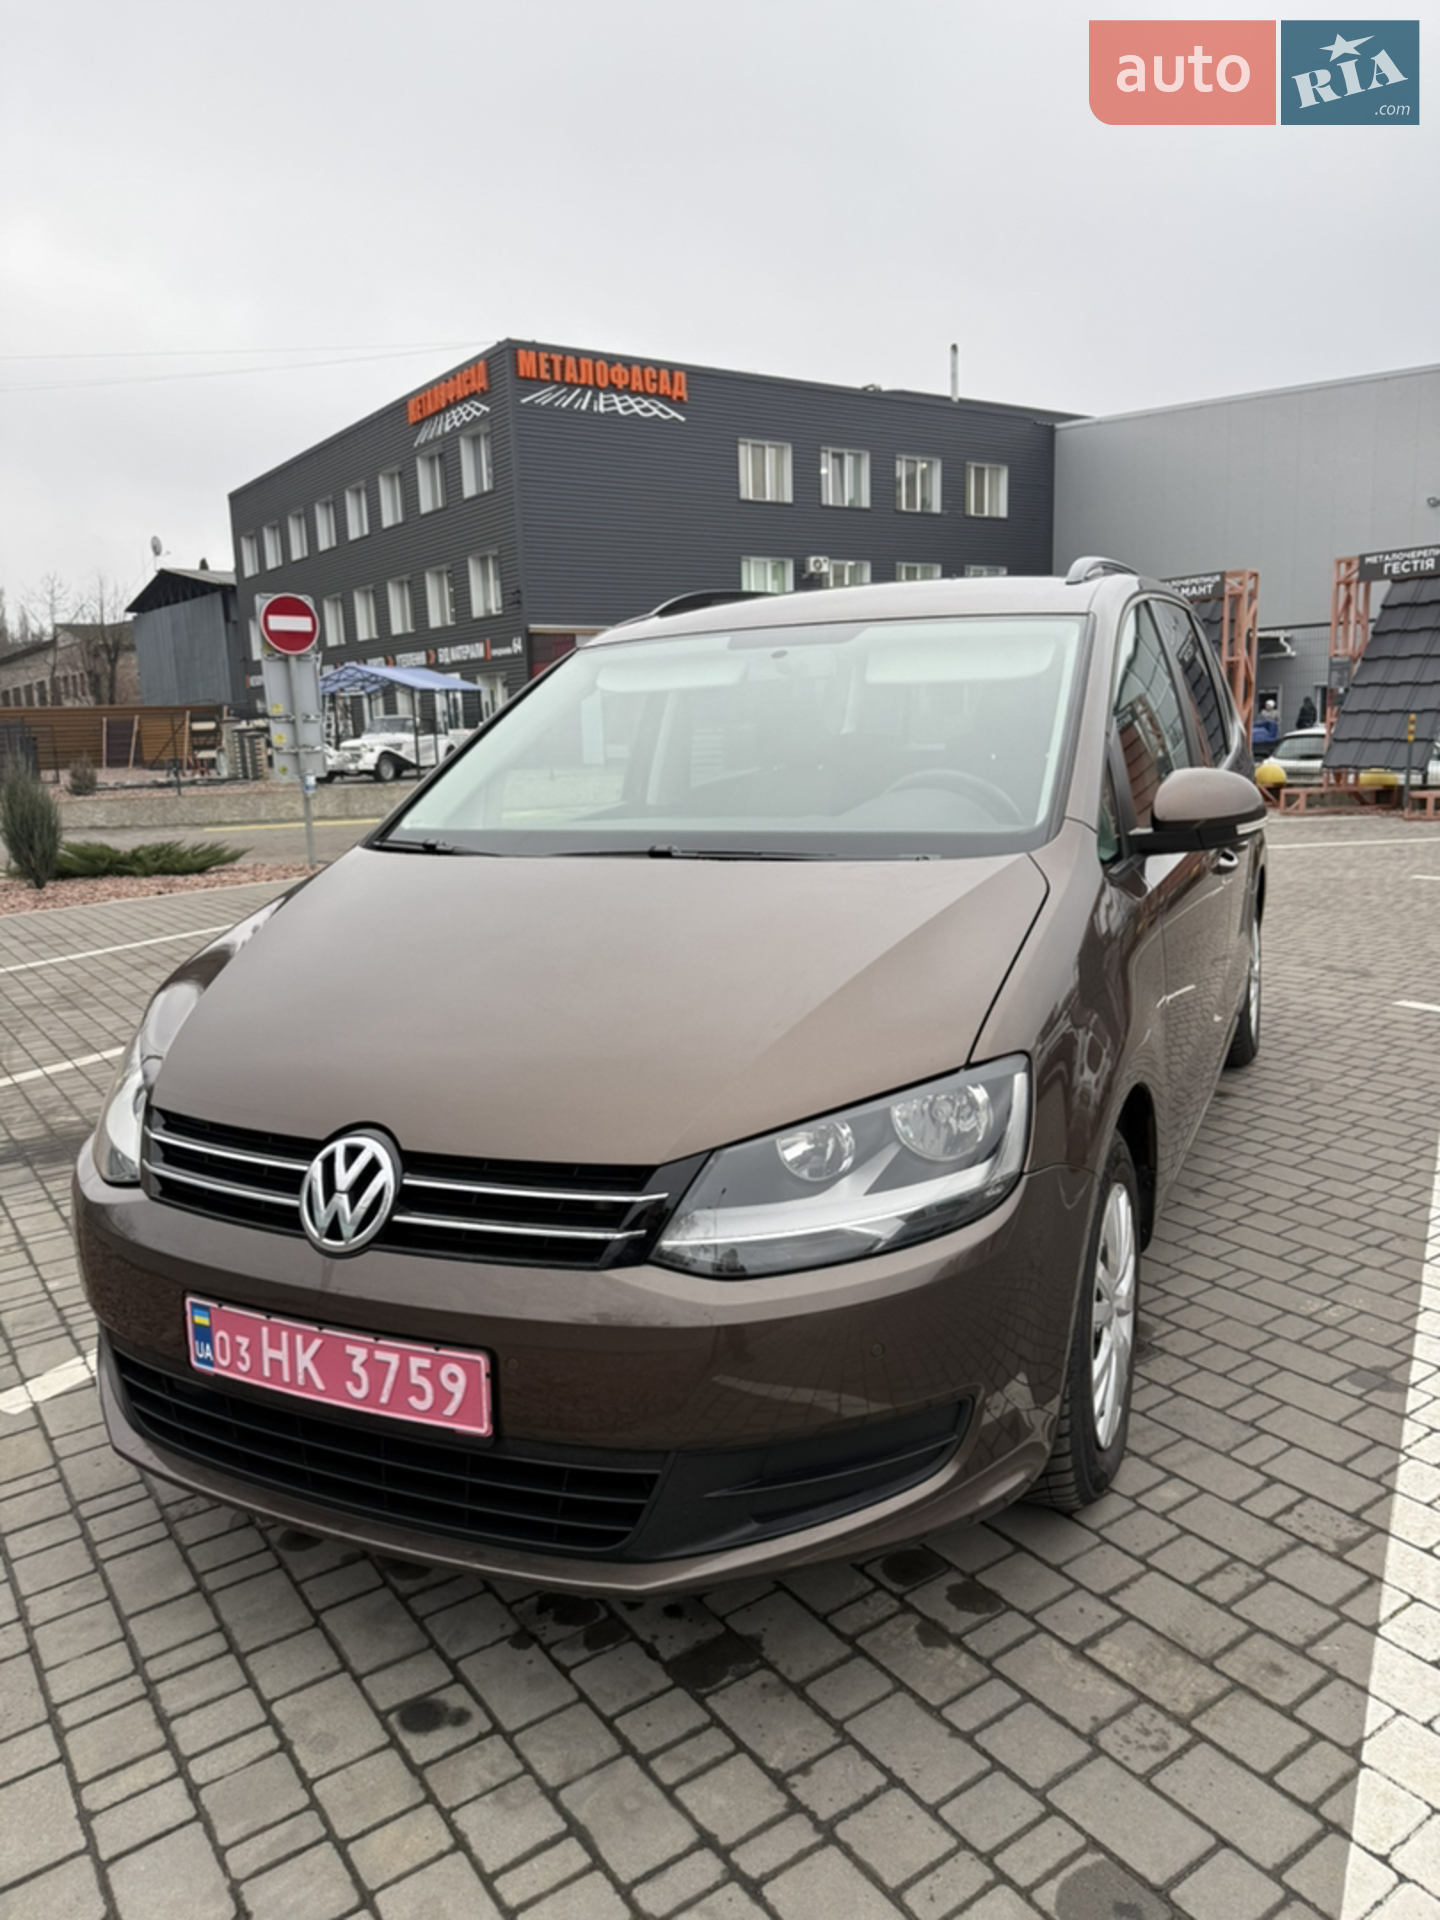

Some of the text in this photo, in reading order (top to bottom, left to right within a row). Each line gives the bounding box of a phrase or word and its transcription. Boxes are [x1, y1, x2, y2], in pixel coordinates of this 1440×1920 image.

[516, 348, 688, 402] МЕТАЛОФАСАД
[1383, 557, 1435, 575] ГЕСТІЯ
[195, 1339, 214, 1361] UA
[215, 1329, 251, 1373] 03
[345, 1344, 467, 1417] 3759
